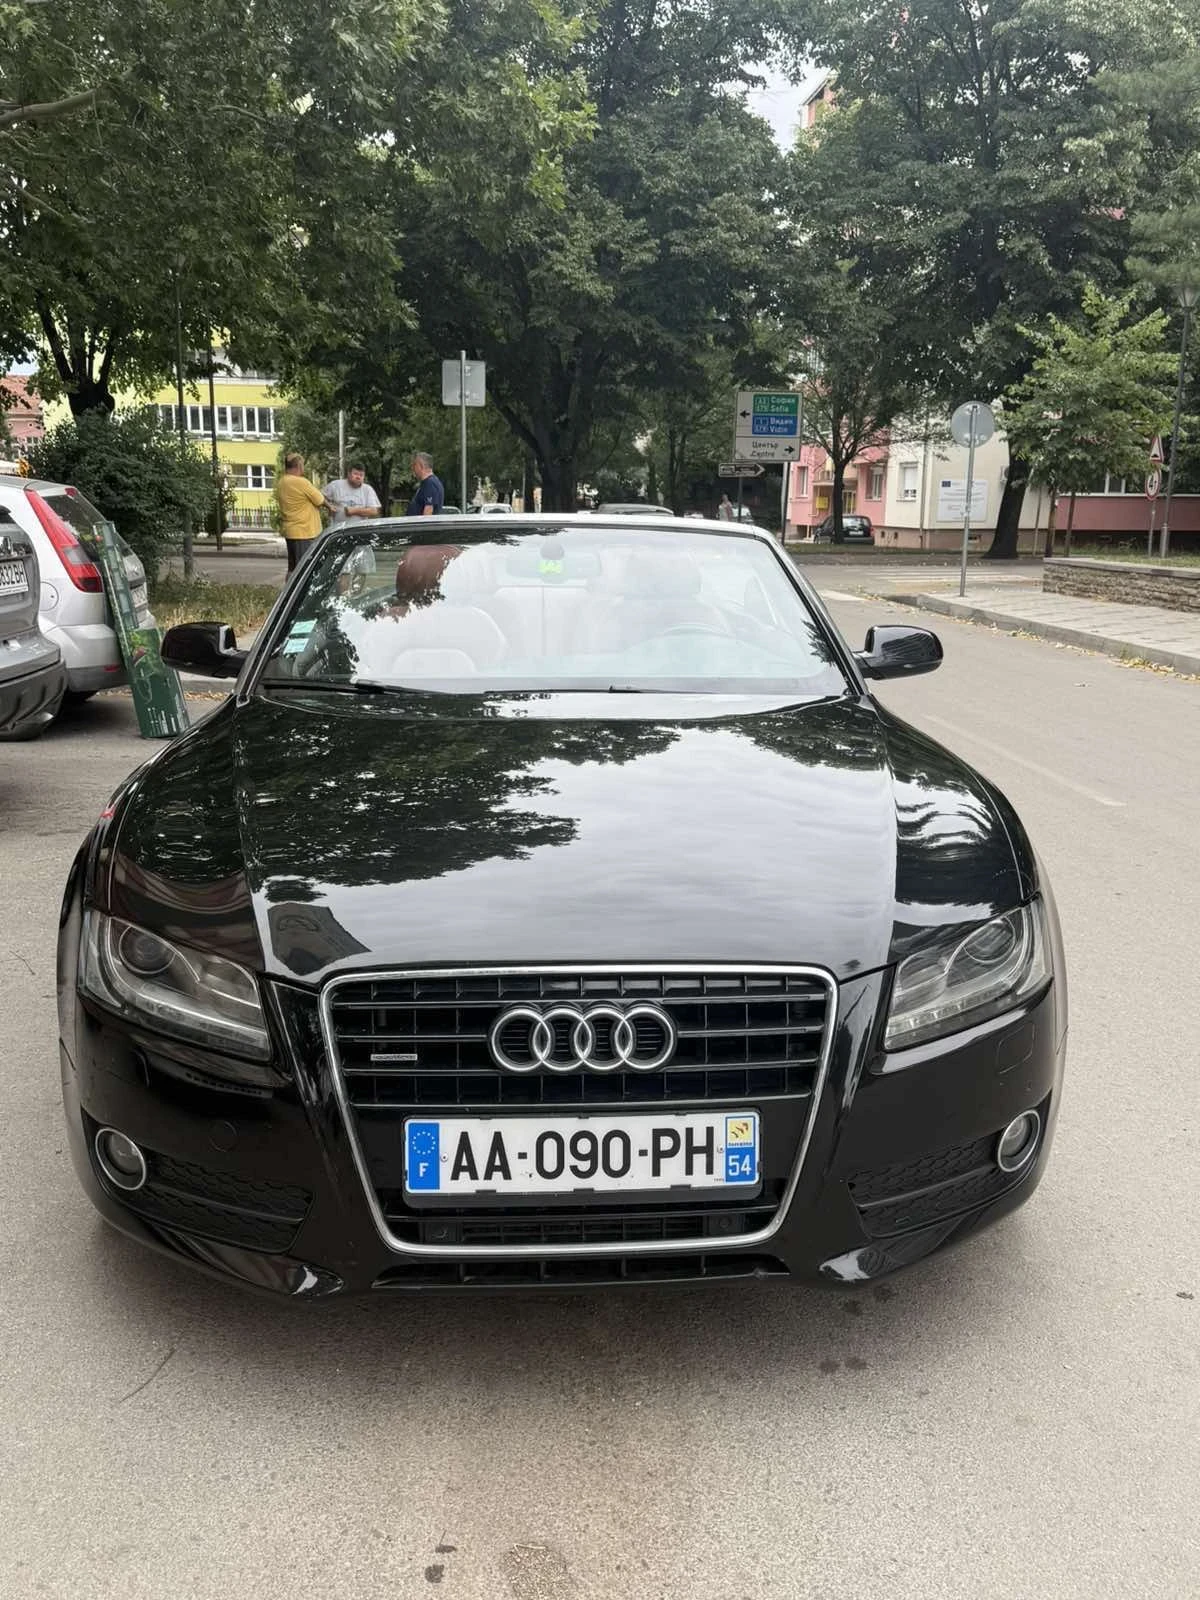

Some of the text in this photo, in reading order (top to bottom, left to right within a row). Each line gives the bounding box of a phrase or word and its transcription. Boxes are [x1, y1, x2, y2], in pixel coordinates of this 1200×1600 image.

[450, 1126, 714, 1180] AA-090-PH
[419, 1162, 430, 1178] F
[728, 1154, 752, 1176] 54
